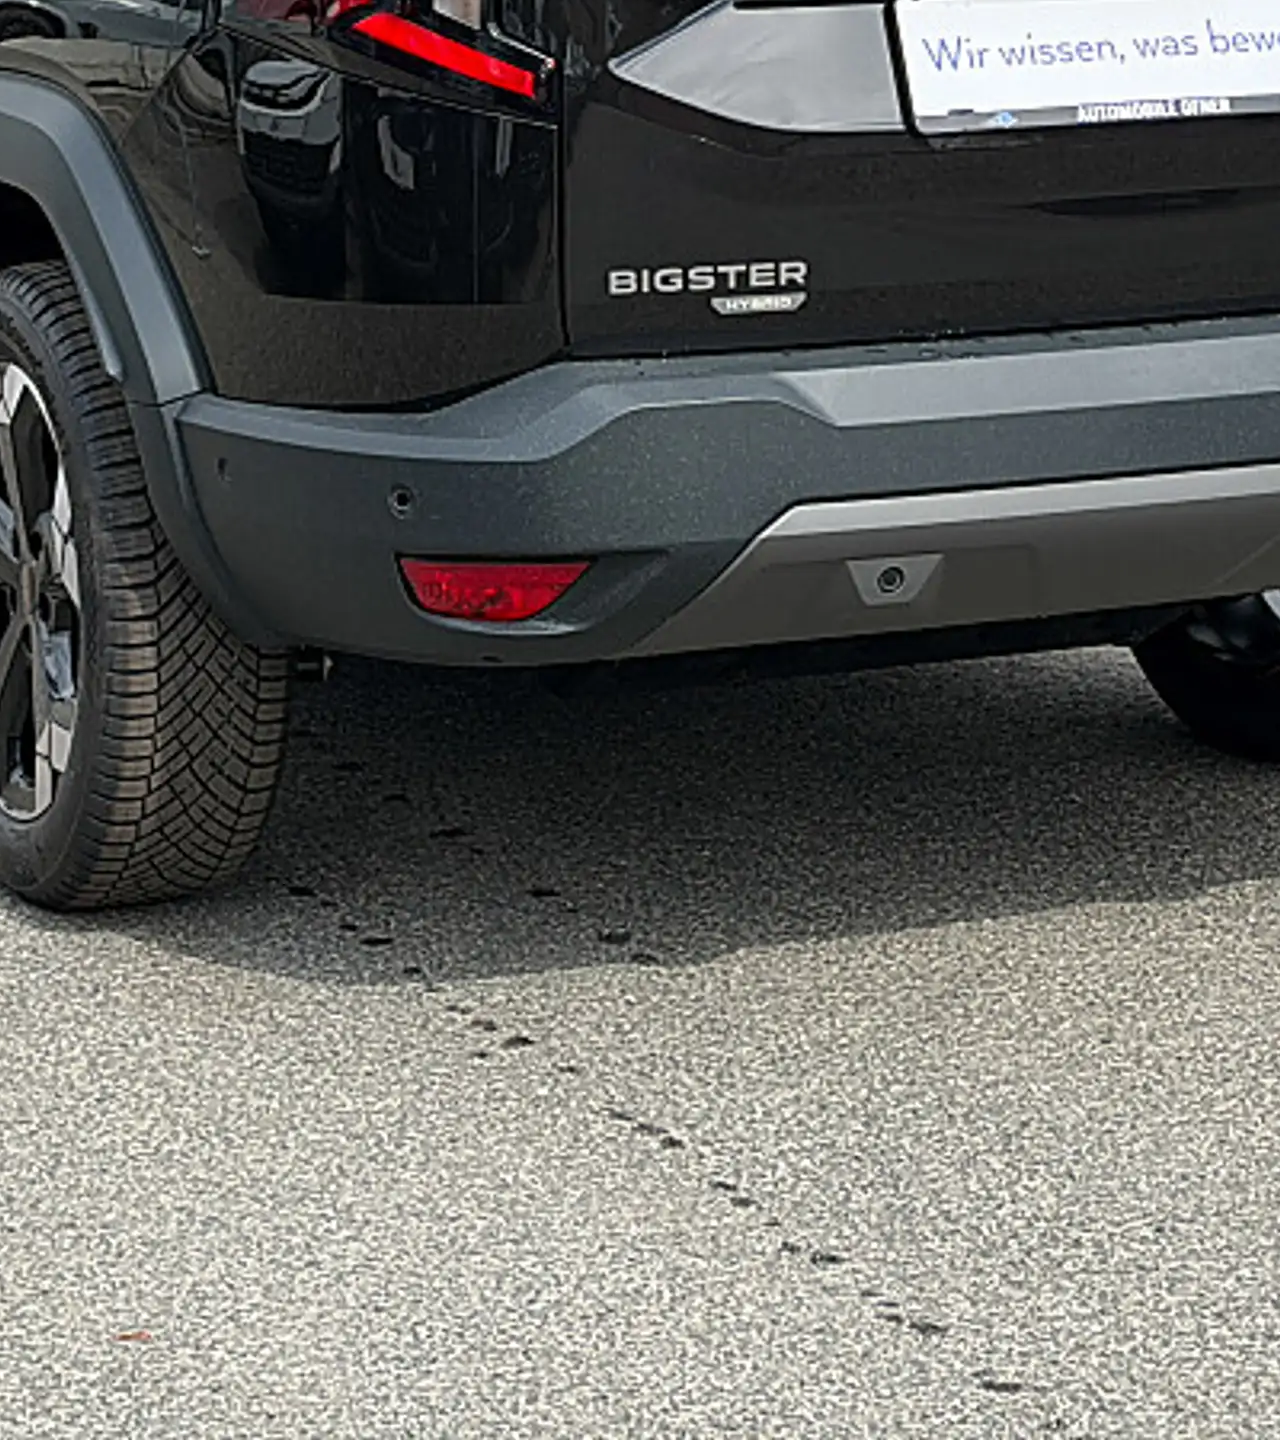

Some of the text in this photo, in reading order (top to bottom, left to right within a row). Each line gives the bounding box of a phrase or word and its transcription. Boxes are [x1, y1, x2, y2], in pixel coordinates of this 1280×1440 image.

[922, 35, 990, 72] Wir
[998, 32, 1126, 64] wissen,
[1133, 38, 1199, 57] was
[608, 262, 808, 295] BIGSTER
